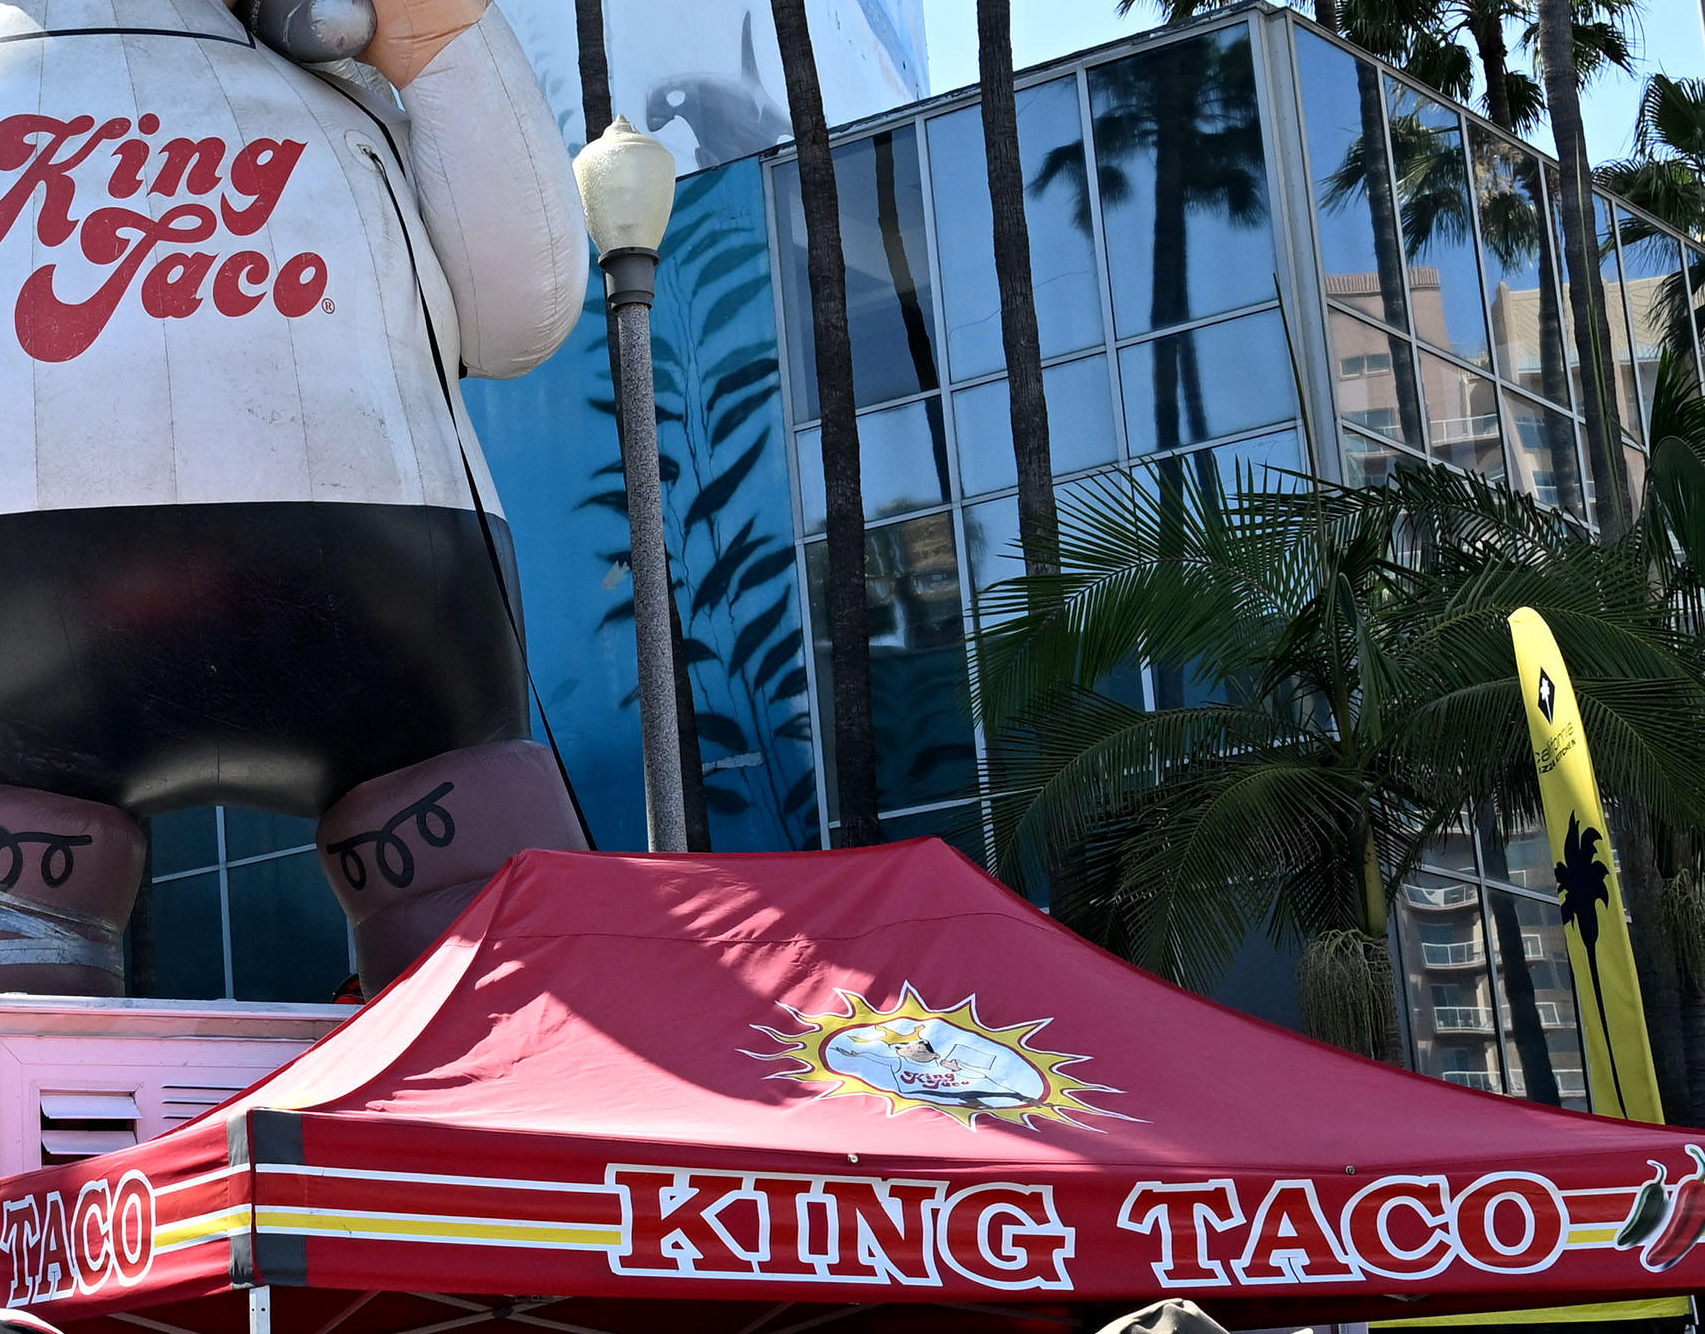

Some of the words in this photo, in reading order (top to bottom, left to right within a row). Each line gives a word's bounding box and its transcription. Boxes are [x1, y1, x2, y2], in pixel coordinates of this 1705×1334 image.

[14, 206, 328, 363] Taco
[900, 1070, 956, 1085] King
[0, 1168, 156, 1309] TACO
[604, 1161, 1076, 1292] KING
[1116, 1170, 1569, 1289] TACO
